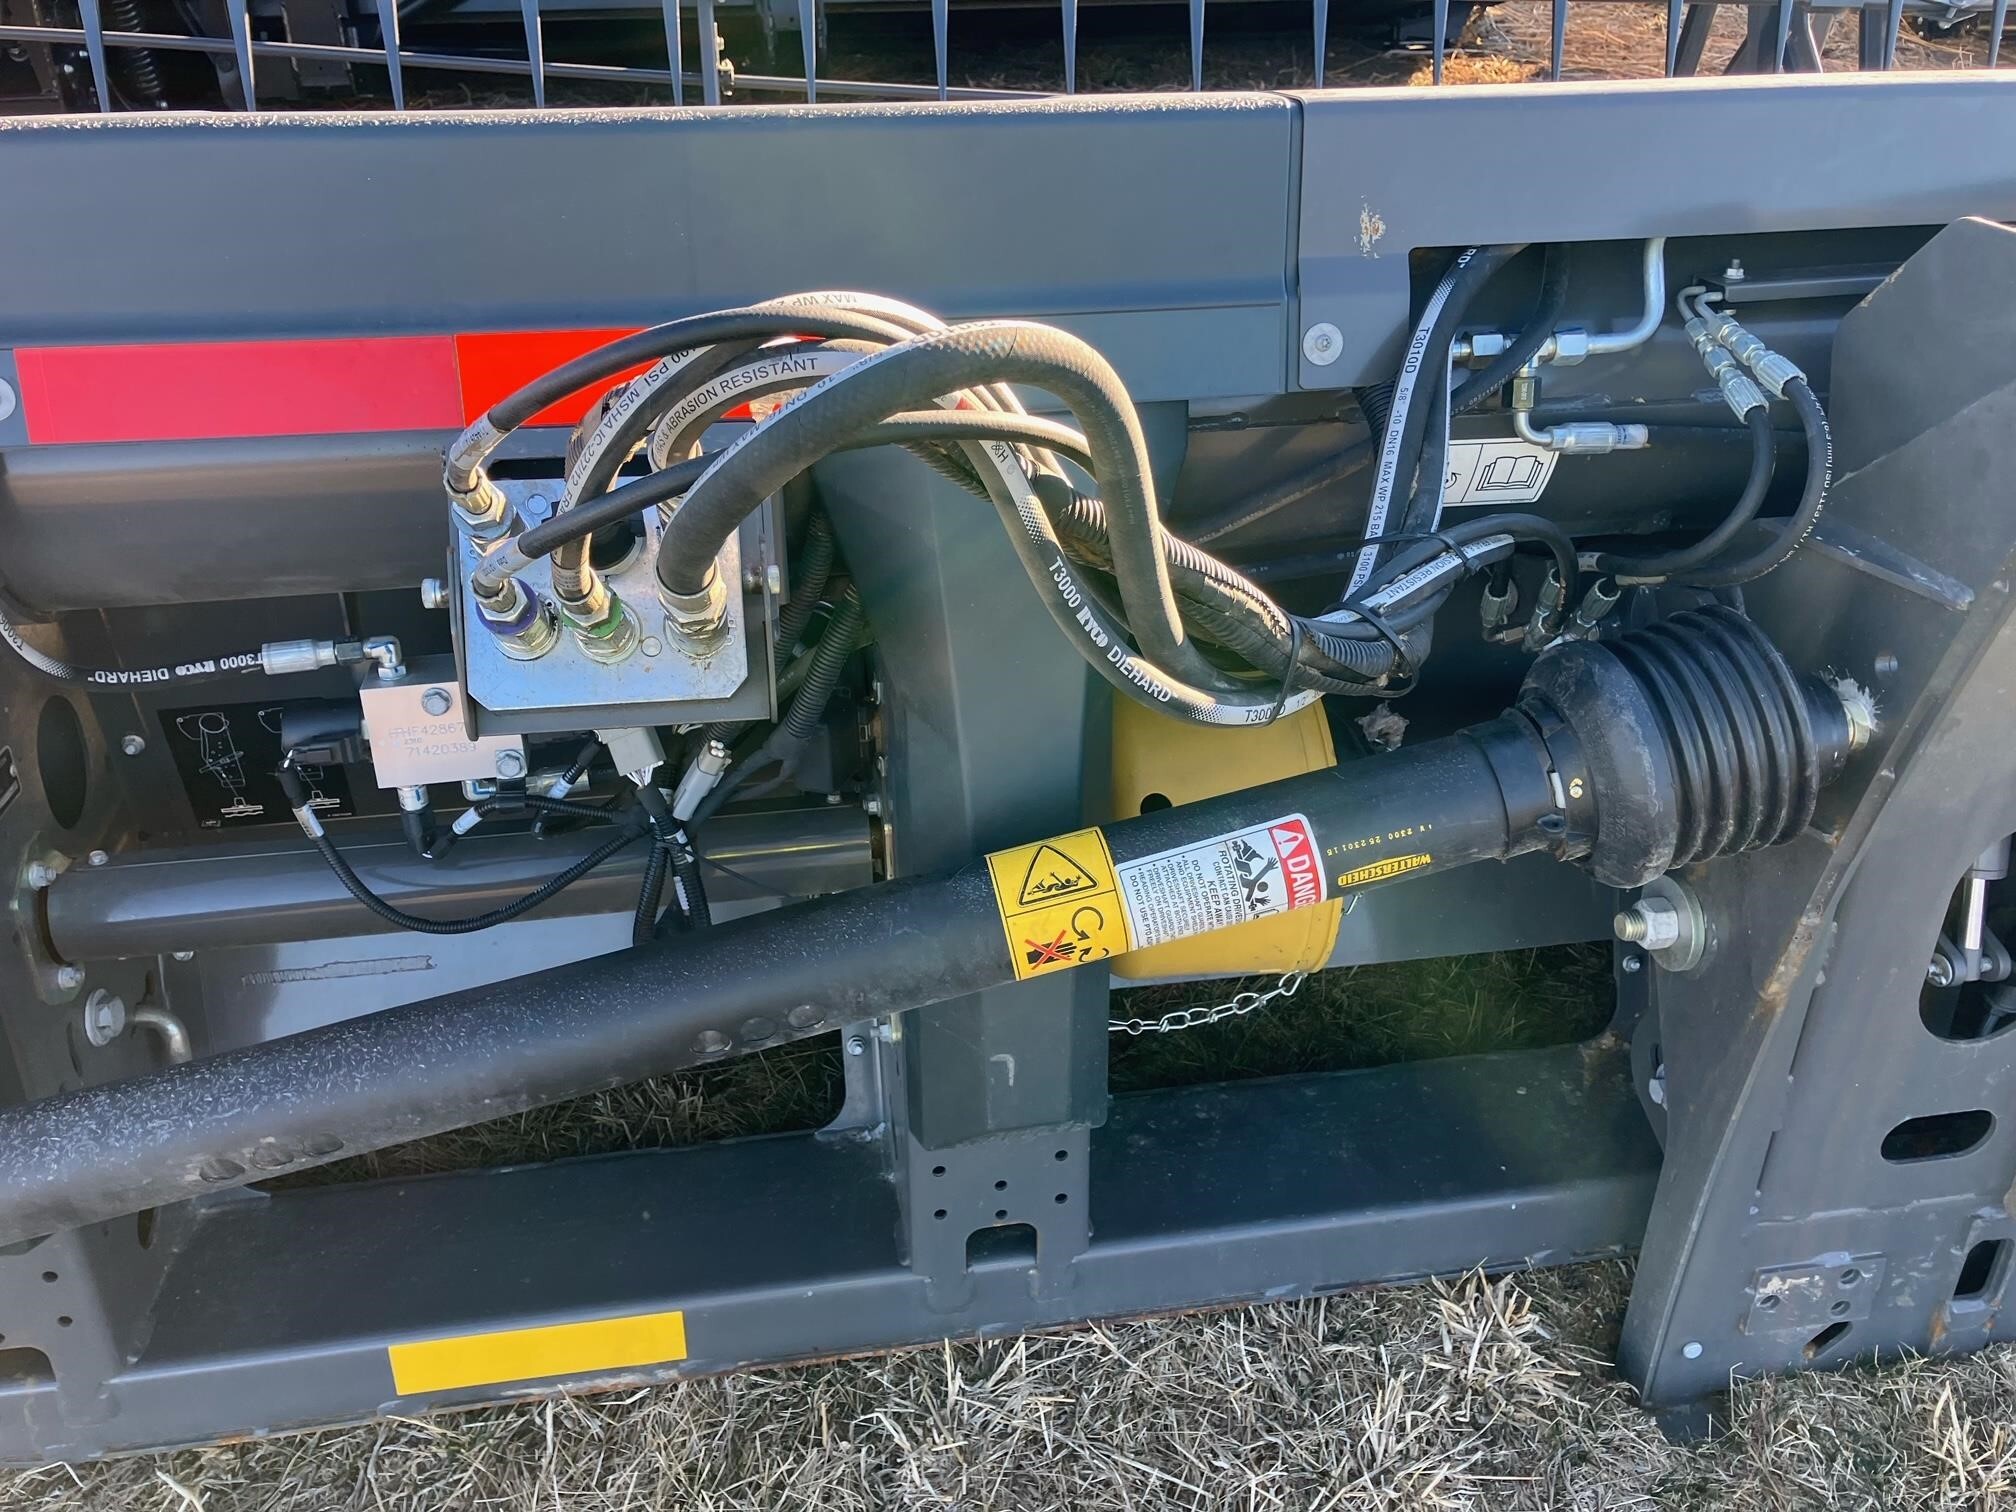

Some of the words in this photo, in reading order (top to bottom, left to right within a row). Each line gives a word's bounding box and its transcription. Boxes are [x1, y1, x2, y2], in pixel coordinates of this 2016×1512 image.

[1404, 327, 1431, 373] T3010D
[643, 362, 669, 387] PSI
[604, 387, 640, 429] MSHA
[668, 386, 718, 433] ABRASION
[719, 357, 818, 394] RESISTANT
[572, 429, 607, 487] IC-227/12
[1385, 430, 1399, 456] DN16
[1380, 461, 1393, 483] MAX
[558, 491, 573, 515] FRA
[1378, 486, 1388, 501] WP
[1372, 504, 1384, 521] 215
[1369, 523, 1380, 537] BA
[1358, 551, 1373, 572] 3100
[1049, 556, 1081, 608] T3000
[1386, 569, 1433, 599] RESISTANT
[220, 652, 263, 670] T3000
[1244, 704, 1286, 723] T300D
[1388, 827, 1413, 840] 2300
[1191, 859, 1200, 872] DO
[1195, 873, 1206, 890] NOT
[1287, 854, 1318, 909] DANG
[1337, 853, 1432, 886] WALTERSCHEID
[1130, 875, 1138, 887] DO
[1134, 889, 1144, 906] NOT
[1139, 907, 1149, 923] USE
[1138, 871, 1152, 903] READING
[1146, 869, 1158, 895] FREELY
[1154, 895, 1162, 906] ON
[1153, 867, 1170, 909] DRIVESHAFT
[1161, 865, 1176, 900] ATTACHED
[1171, 901, 1178, 909] AT
[1168, 863, 1184, 904] DRIVESHAFT
[1176, 861, 1185, 876] AND
[1181, 877, 1196, 914] EQUIPMENT
[1182, 859, 1191, 871] ALL
[1187, 872, 1202, 911] DRIVESHAFT
[1207, 879, 1221, 907] KEEP
[1213, 861, 1227, 892] CONTACT
[1221, 893, 1230, 905] CAN
[1219, 849, 1239, 897] ROTATING
[1230, 898, 1245, 922] DRIVES
[1200, 890, 1214, 921] OPERATE
